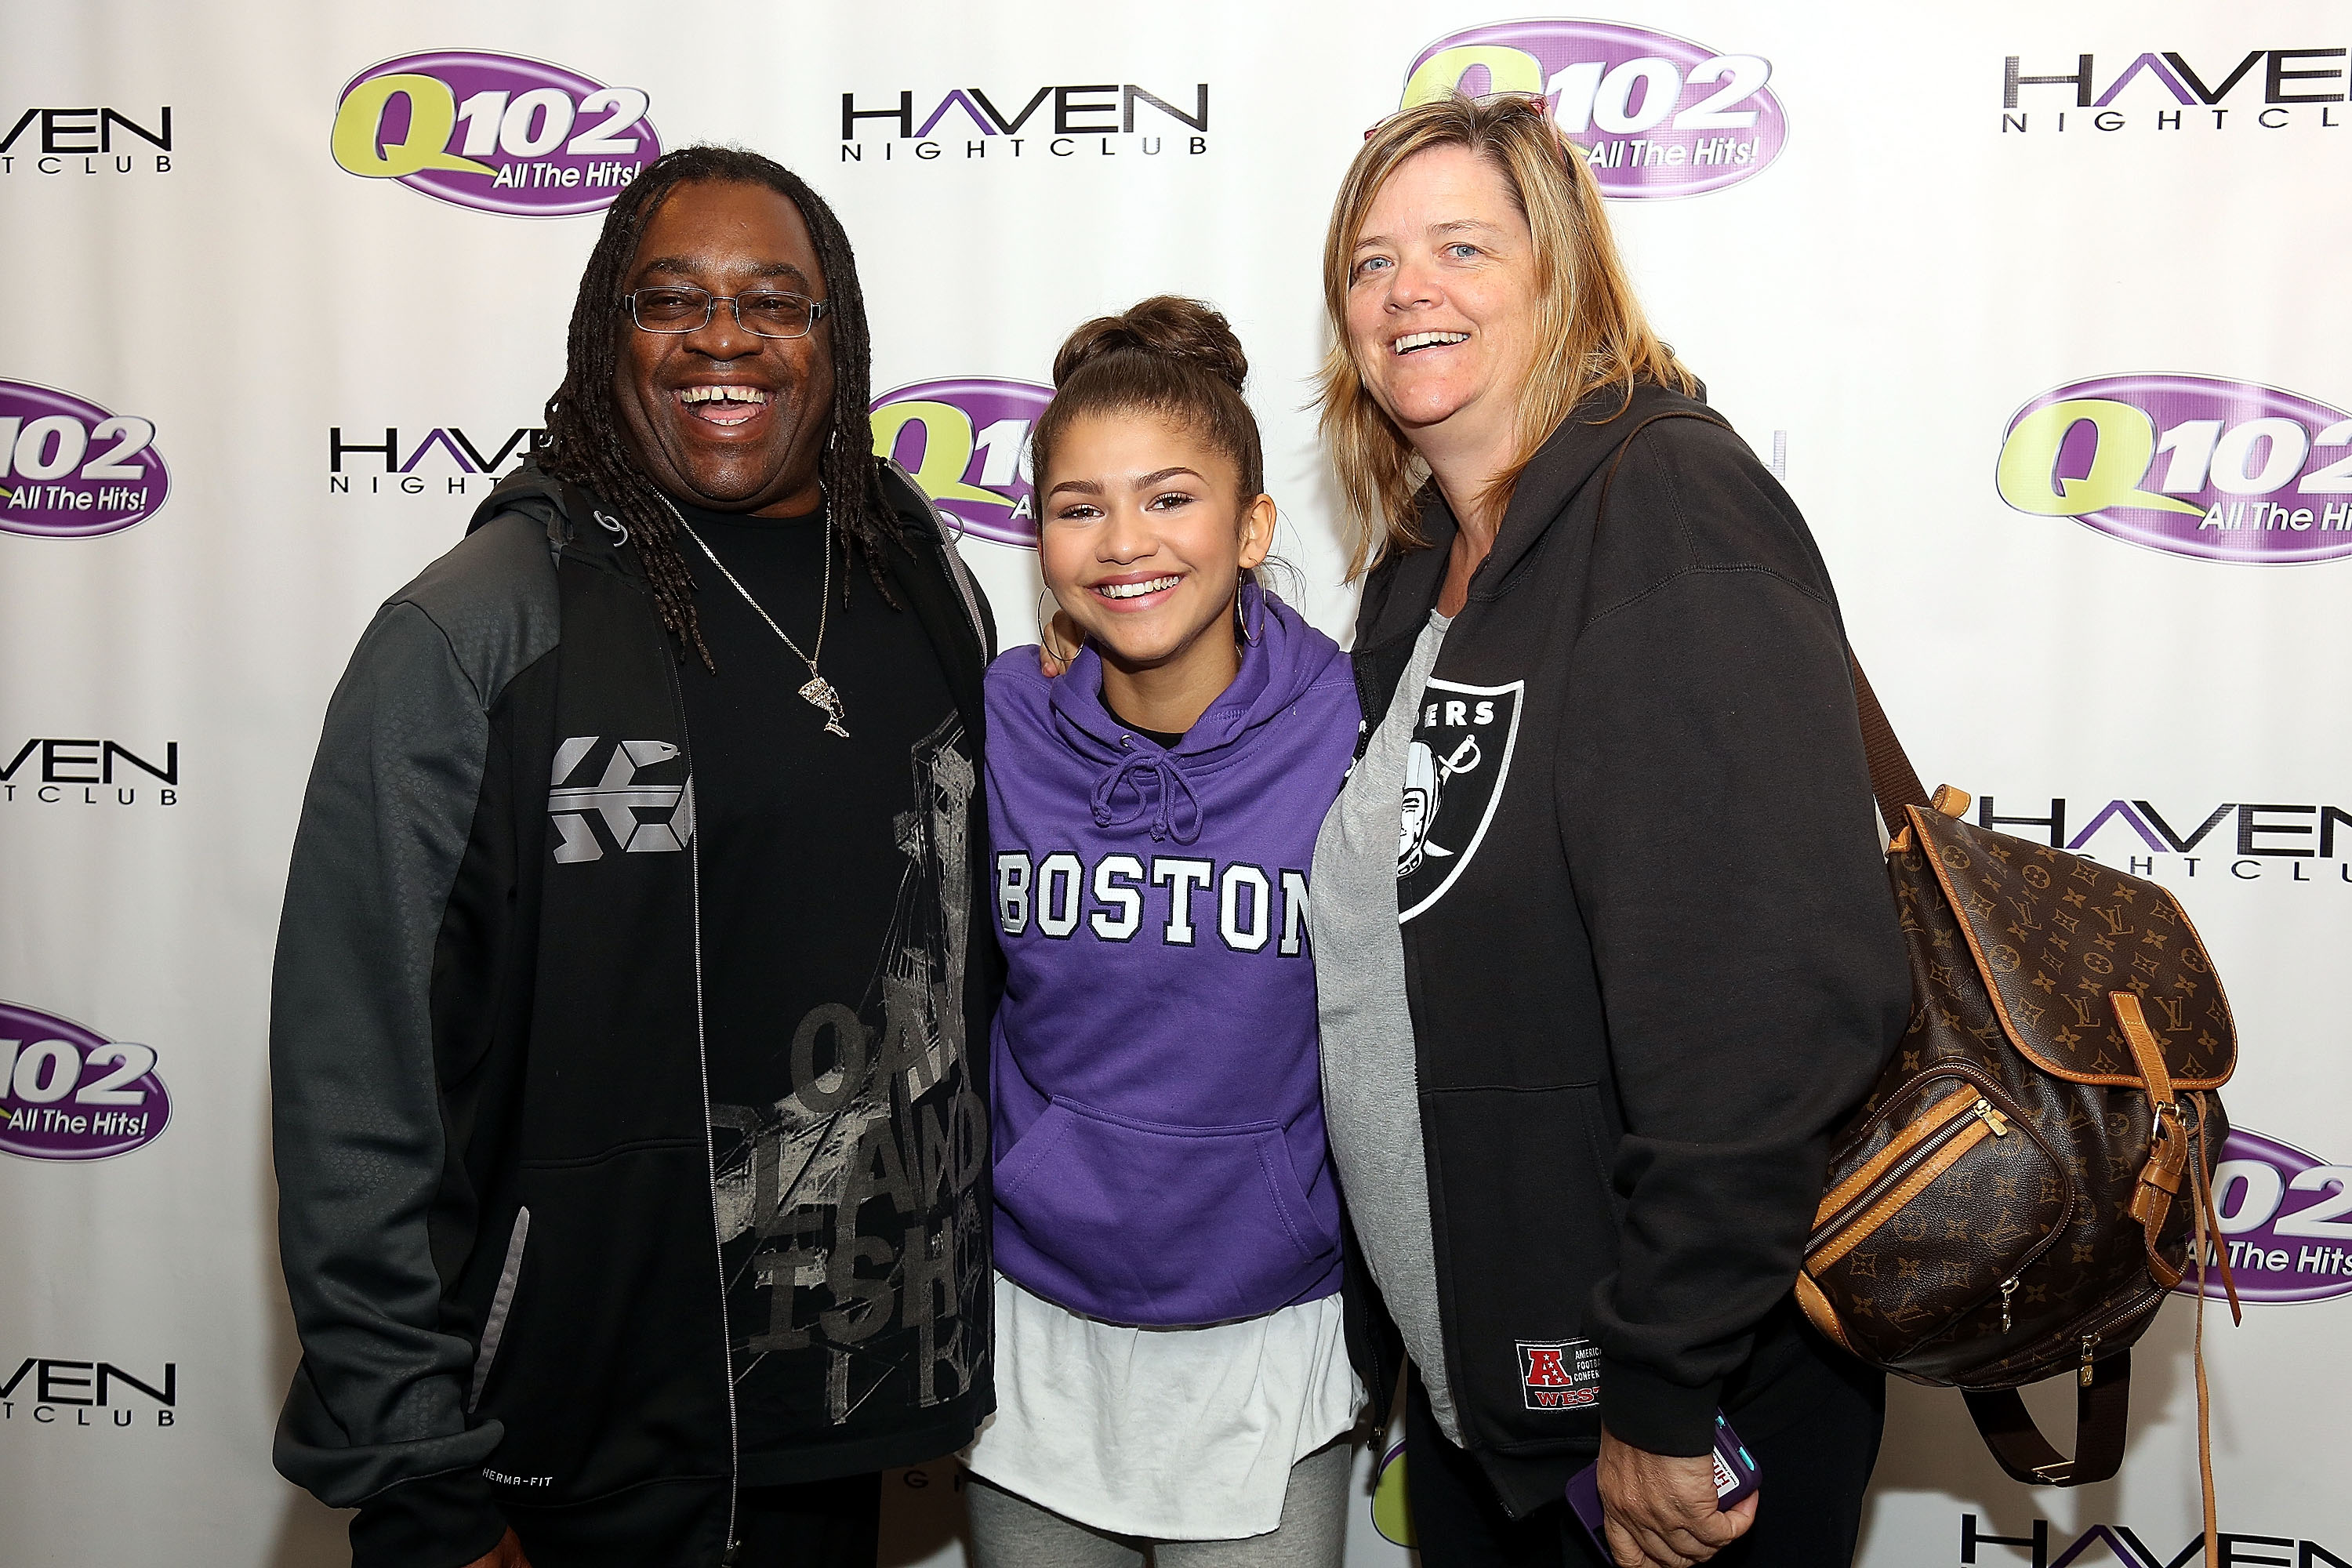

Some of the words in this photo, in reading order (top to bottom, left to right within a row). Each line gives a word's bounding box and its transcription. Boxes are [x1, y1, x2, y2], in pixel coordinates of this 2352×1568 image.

[2003, 48, 2352, 108] HAVE
[331, 74, 650, 179] Q102
[842, 84, 1208, 140] HAVEN
[2002, 107, 2339, 132] NIGHTCL
[1, 155, 172, 174] TCLUB
[841, 136, 1207, 162] NIGHTCLUB
[1587, 140, 1625, 168] All
[1631, 140, 1686, 166] The
[1693, 136, 1761, 165] Hits!
[492, 163, 526, 188] All
[532, 165, 579, 188] The
[585, 161, 642, 187] Hits!
[869, 401, 1036, 508] Q1
[7, 485, 42, 510] All
[46, 485, 93, 510] The
[97, 486, 147, 510] Hits!
[2198, 503, 2246, 531] All
[2251, 501, 2314, 532] The
[5, 785, 177, 805] TCLUB
[790, 982, 970, 1113] OAK
[7, 1107, 38, 1131] All
[43, 1109, 87, 1134] The
[92, 1111, 149, 1136] Hits!
[754, 1090, 988, 1239] LAND
[2228, 1240, 2289, 1272] The
[749, 1216, 957, 1355] ISH
[3, 1402, 174, 1426] TCLUB
[482, 1468, 553, 1486] HERMA-FIT
